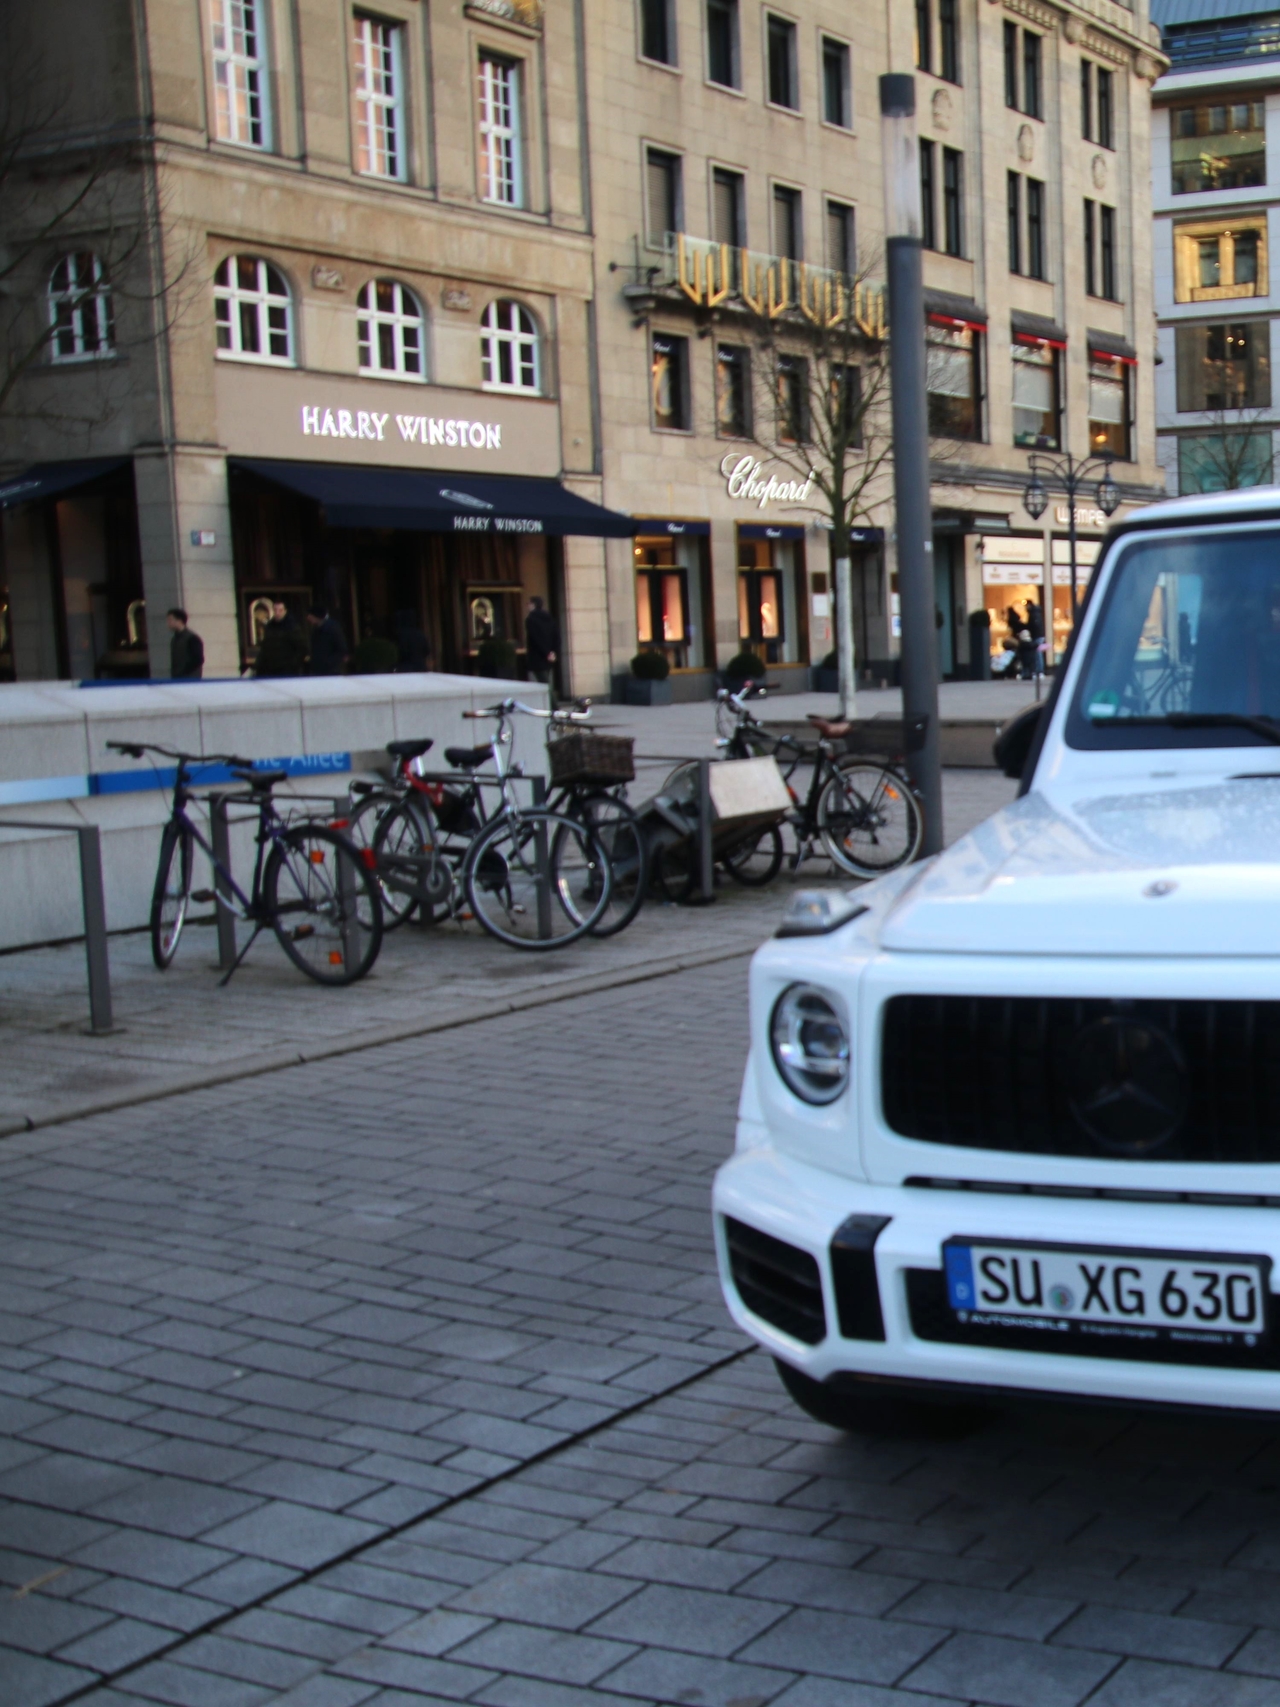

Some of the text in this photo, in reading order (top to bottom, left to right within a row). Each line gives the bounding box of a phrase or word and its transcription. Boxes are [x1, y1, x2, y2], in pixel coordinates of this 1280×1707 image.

[302, 405, 501, 449] HARRY WINSTON
[721, 453, 816, 509] Chopard
[453, 515, 544, 533] HARRY WINSTON
[979, 1256, 1256, 1324] SU XG 630
